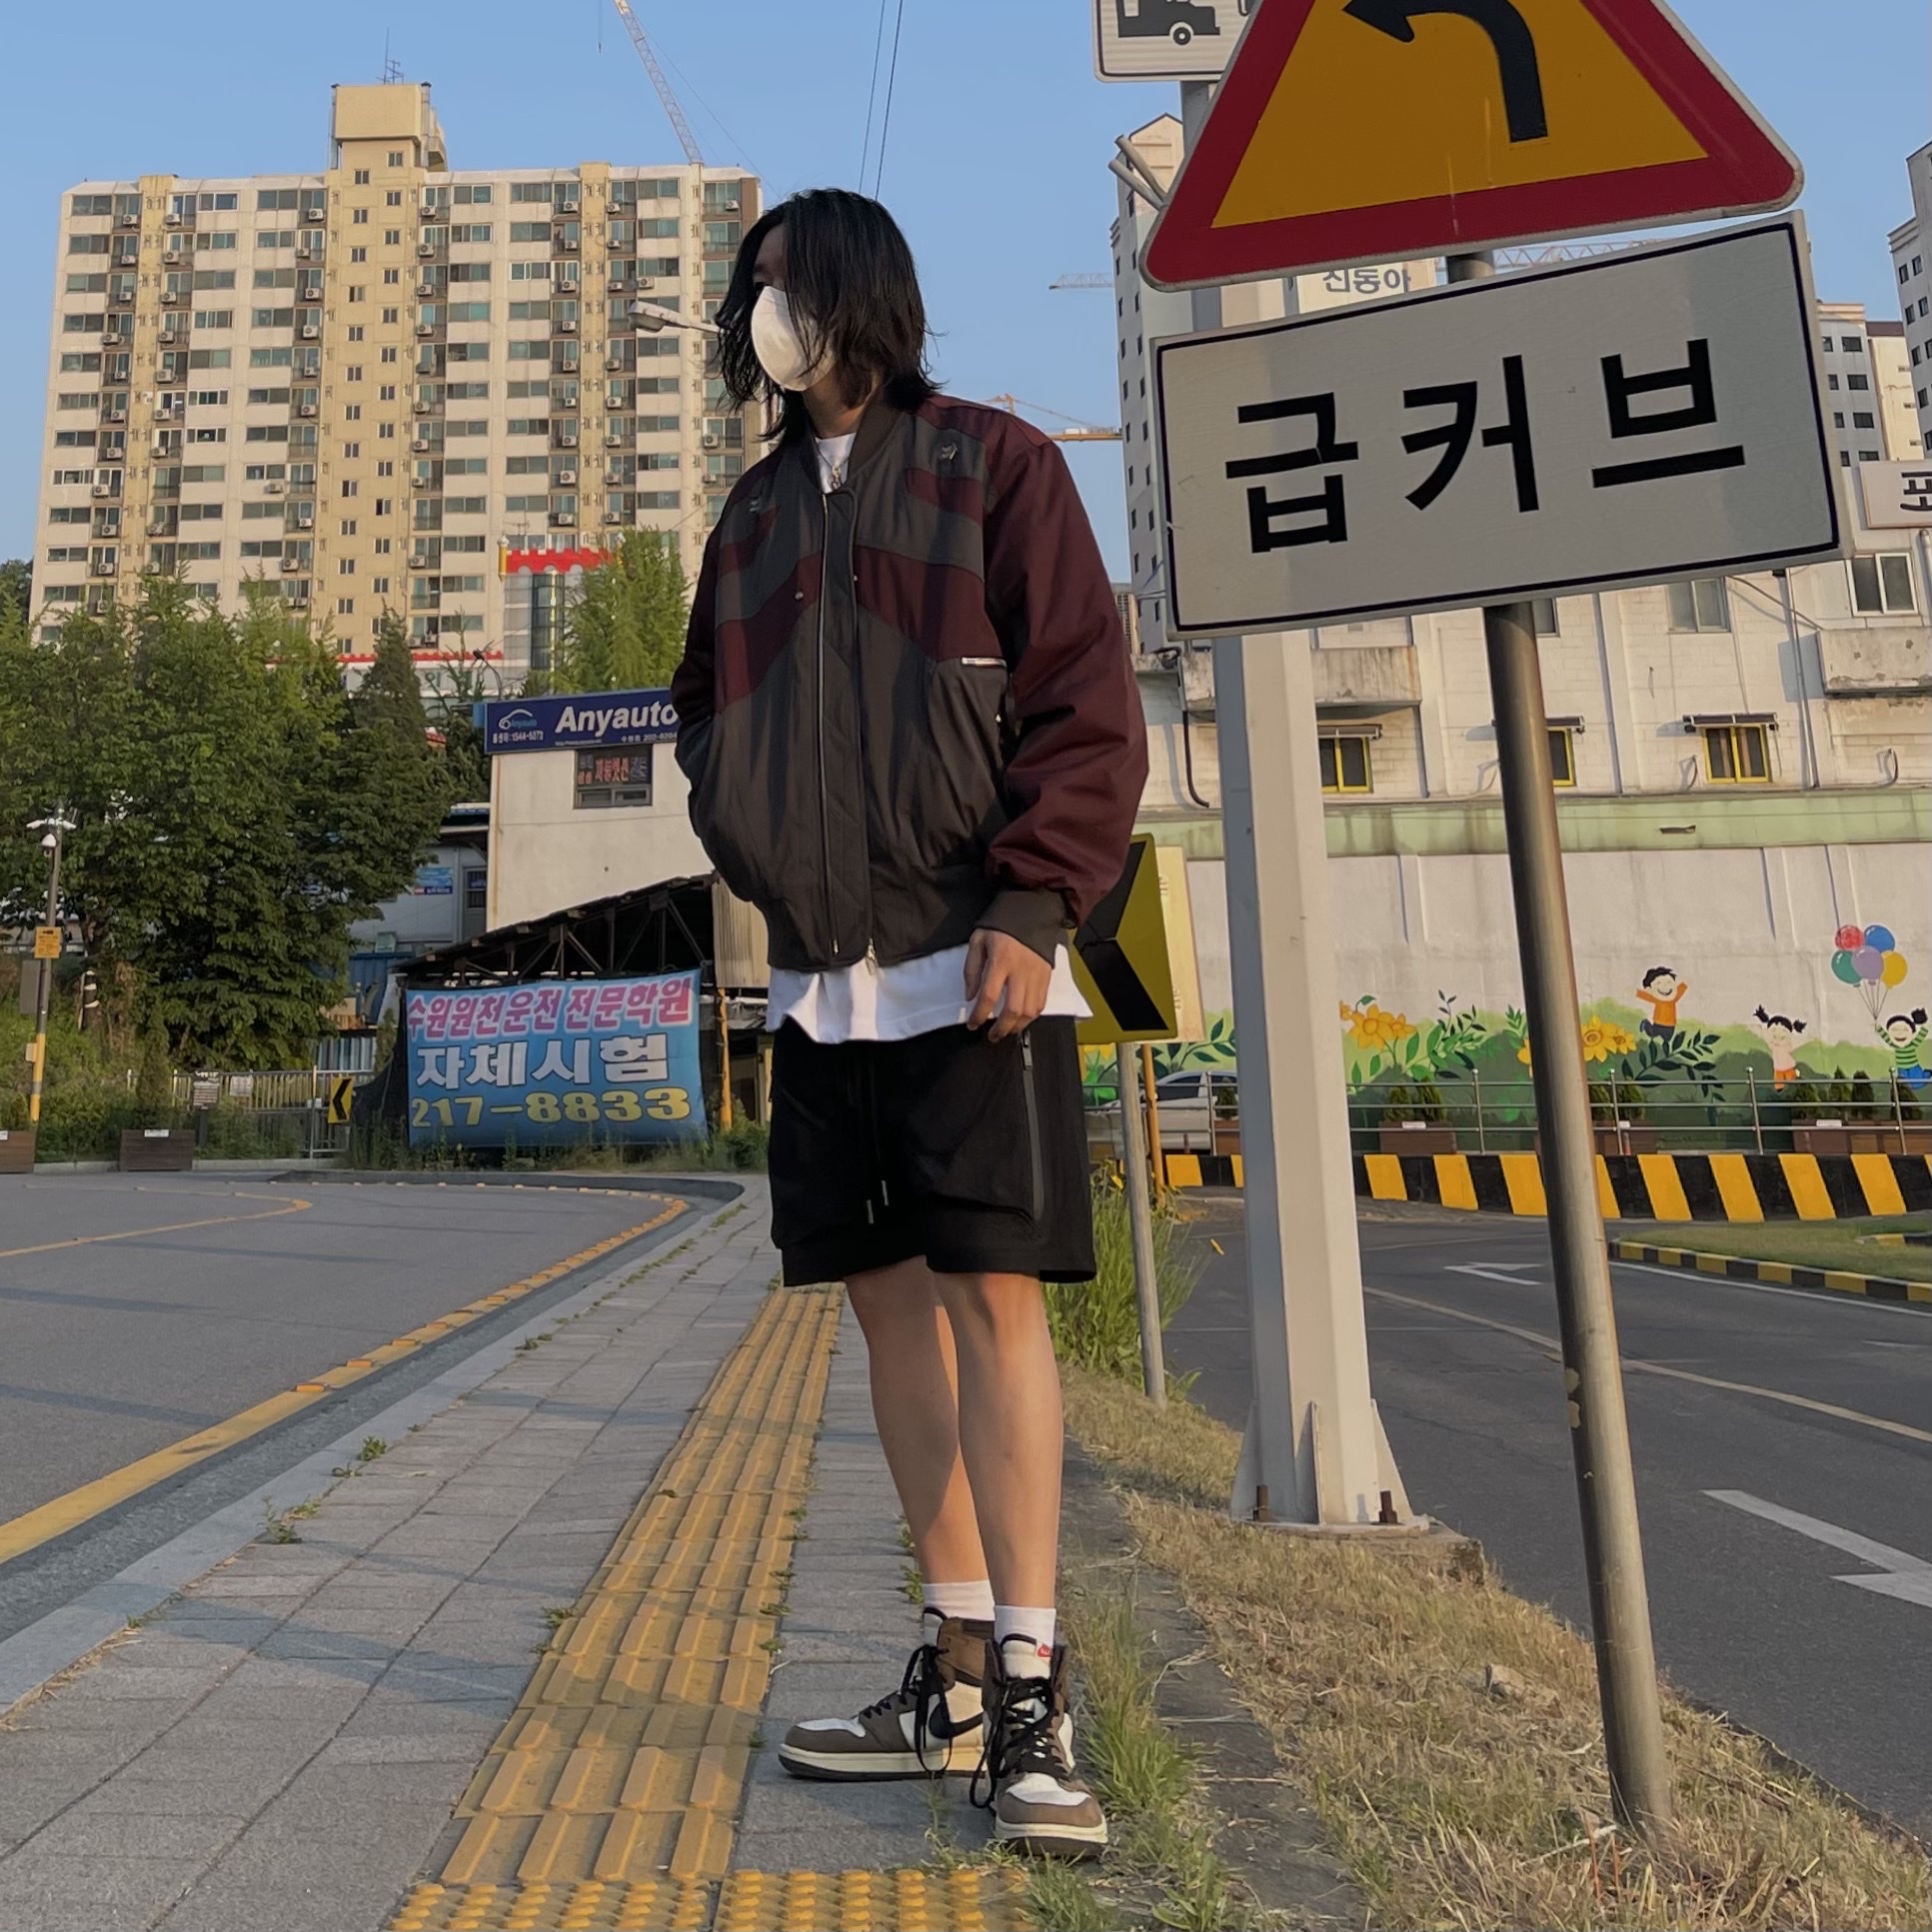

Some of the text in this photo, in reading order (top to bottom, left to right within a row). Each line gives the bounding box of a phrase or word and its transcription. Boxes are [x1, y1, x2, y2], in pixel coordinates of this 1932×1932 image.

[1322, 268, 1412, 294] 신동아
[1225, 338, 1745, 553] 급커브
[555, 701, 679, 738] Anyauto
[416, 1032, 670, 1090] 자체시험
[411, 1086, 692, 1128] 217-8833
